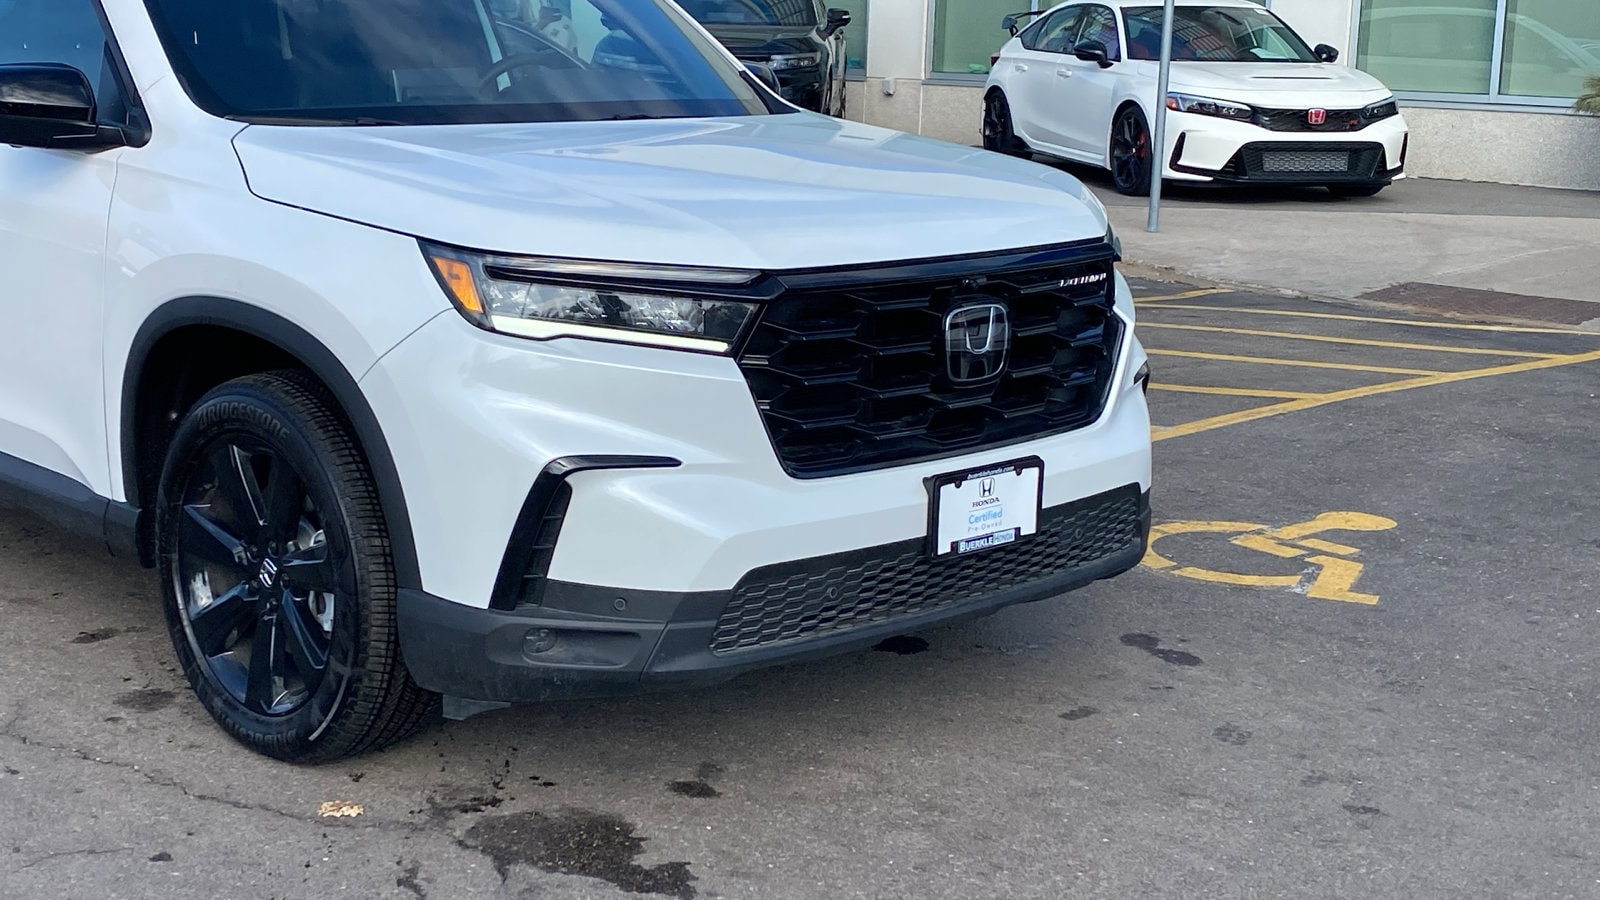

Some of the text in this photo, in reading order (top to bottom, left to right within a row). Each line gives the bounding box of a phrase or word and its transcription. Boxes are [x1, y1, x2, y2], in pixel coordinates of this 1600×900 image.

[197, 402, 290, 439] BRIDGESTONE
[972, 497, 1000, 508] HONDA
[968, 507, 1003, 525] Certified
[960, 537, 993, 551] BUERKLE
